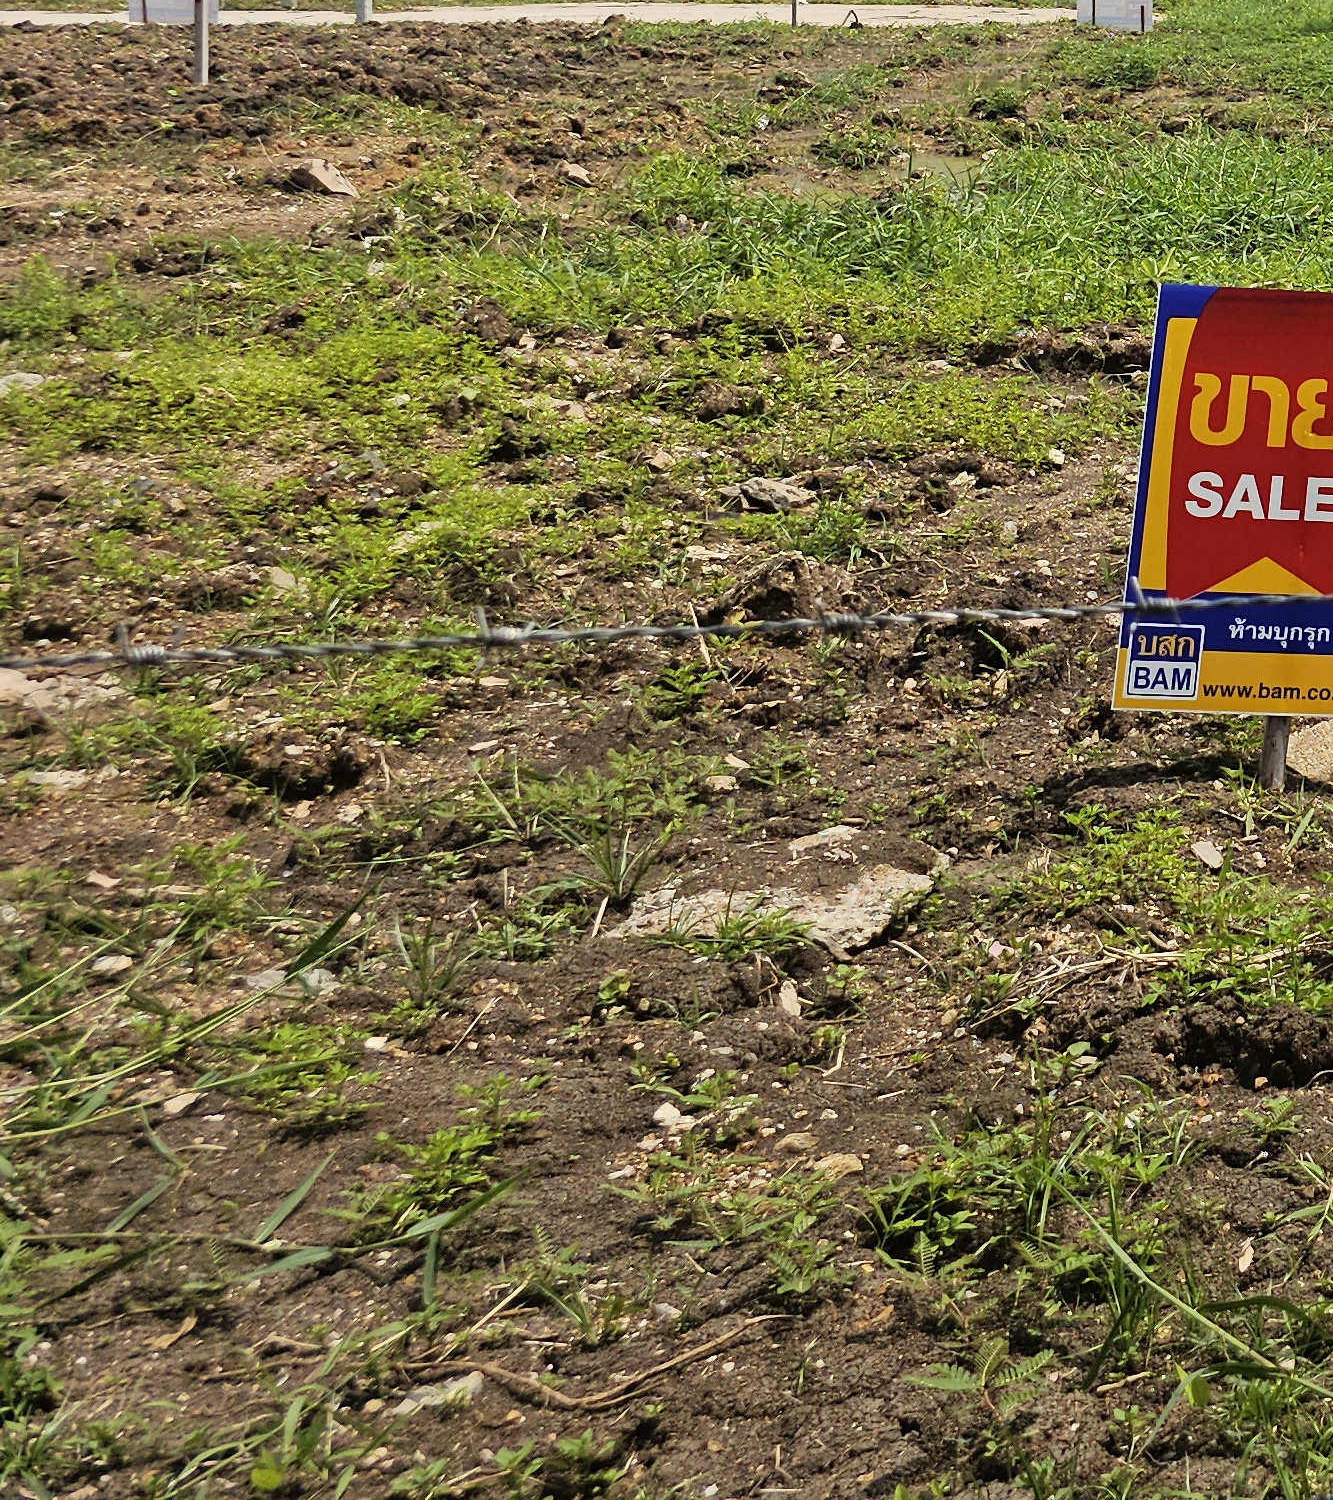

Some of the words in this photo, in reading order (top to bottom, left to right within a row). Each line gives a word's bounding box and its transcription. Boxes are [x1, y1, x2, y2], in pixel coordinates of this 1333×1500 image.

[1137, 633, 1195, 658] บสก
[1228, 617, 1331, 649] ห้ามบุกรุก
[1133, 666, 1192, 691] BAM
